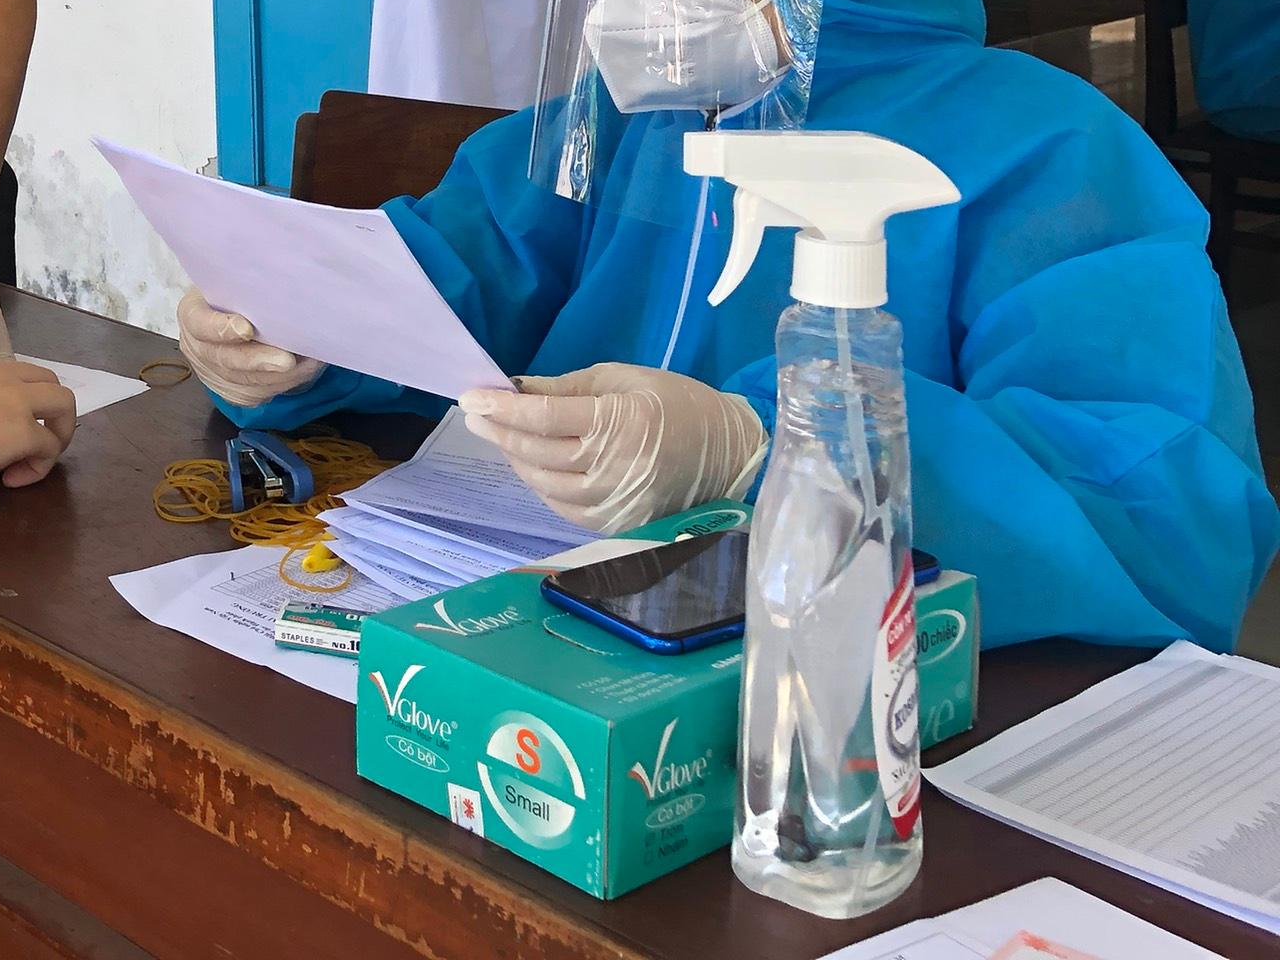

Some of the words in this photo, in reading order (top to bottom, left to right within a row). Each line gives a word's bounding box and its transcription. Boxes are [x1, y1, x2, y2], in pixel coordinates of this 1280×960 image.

[281, 632, 315, 645] STAPLES
[417, 747, 437, 768] bột
[515, 728, 542, 775] S
[505, 784, 551, 823] Small
